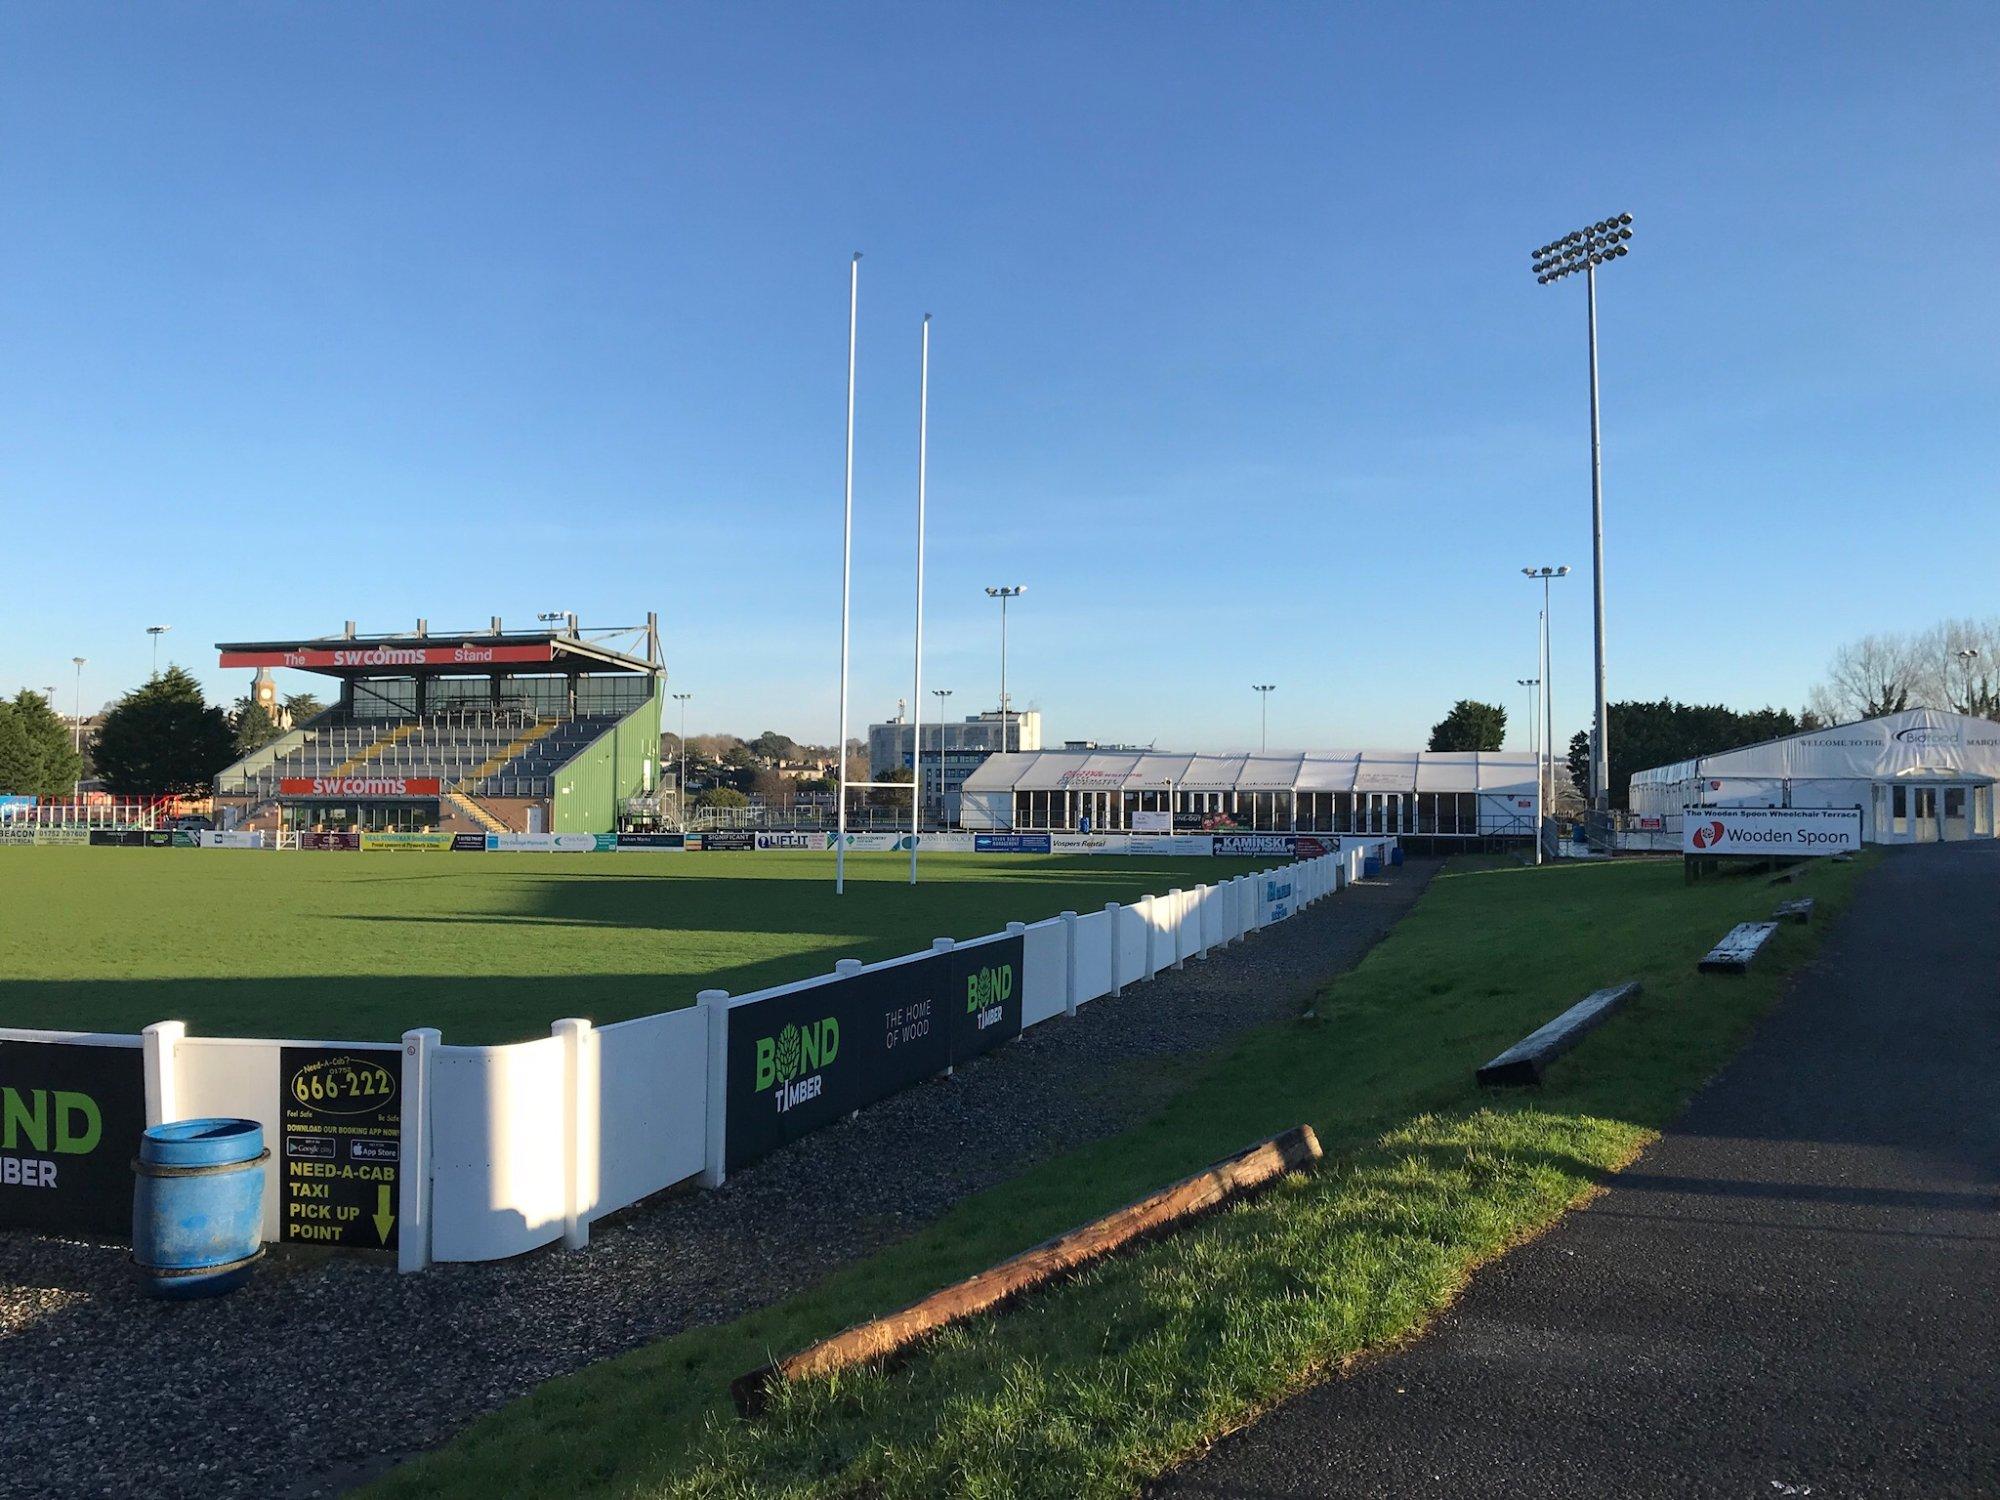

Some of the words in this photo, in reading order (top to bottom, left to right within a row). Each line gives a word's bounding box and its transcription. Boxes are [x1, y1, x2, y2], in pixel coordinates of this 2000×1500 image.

[284, 653, 306, 666] The
[333, 649, 426, 666] swcomms
[454, 649, 493, 662] Stand
[1800, 739, 1847, 747] WELCOME
[1865, 739, 1885, 747] THE
[313, 778, 407, 794] swcomms
[1741, 810, 1767, 818] Spoon
[1770, 810, 1819, 818] Wheelchair
[769, 835, 808, 845] LIFT-IT
[1053, 840, 1080, 848] Vospers
[1223, 837, 1286, 848] KAMINSKI
[1727, 829, 1792, 843] Wooden
[1797, 829, 1849, 846] Spoon
[967, 964, 1013, 1014] BOND
[885, 1008, 903, 1029] THE
[906, 999, 932, 1023] HOME
[977, 1005, 1003, 1031] TIMBER
[886, 1030, 899, 1049] OF
[902, 1019, 930, 1043] WOOD
[755, 1016, 840, 1093] BOND
[303, 1056, 350, 1074] Need-A-Cab?
[296, 1069, 390, 1100] 666-222
[775, 1074, 822, 1114] TIMBER
[300, 1110, 313, 1118] Safe
[286, 1124, 322, 1133] DOWNLOAD
[323, 1126, 337, 1134] OUR
[338, 1127, 367, 1135] BOOKING
[369, 1127, 381, 1135] APP
[298, 1144, 320, 1155] Google
[0, 1157, 57, 1188] BER
[289, 1161, 395, 1181] NEED-A-CAB
[289, 1182, 329, 1198] TAXI
[289, 1203, 332, 1219] PICK
[336, 1206, 360, 1221] UP
[289, 1223, 343, 1240] POINT
